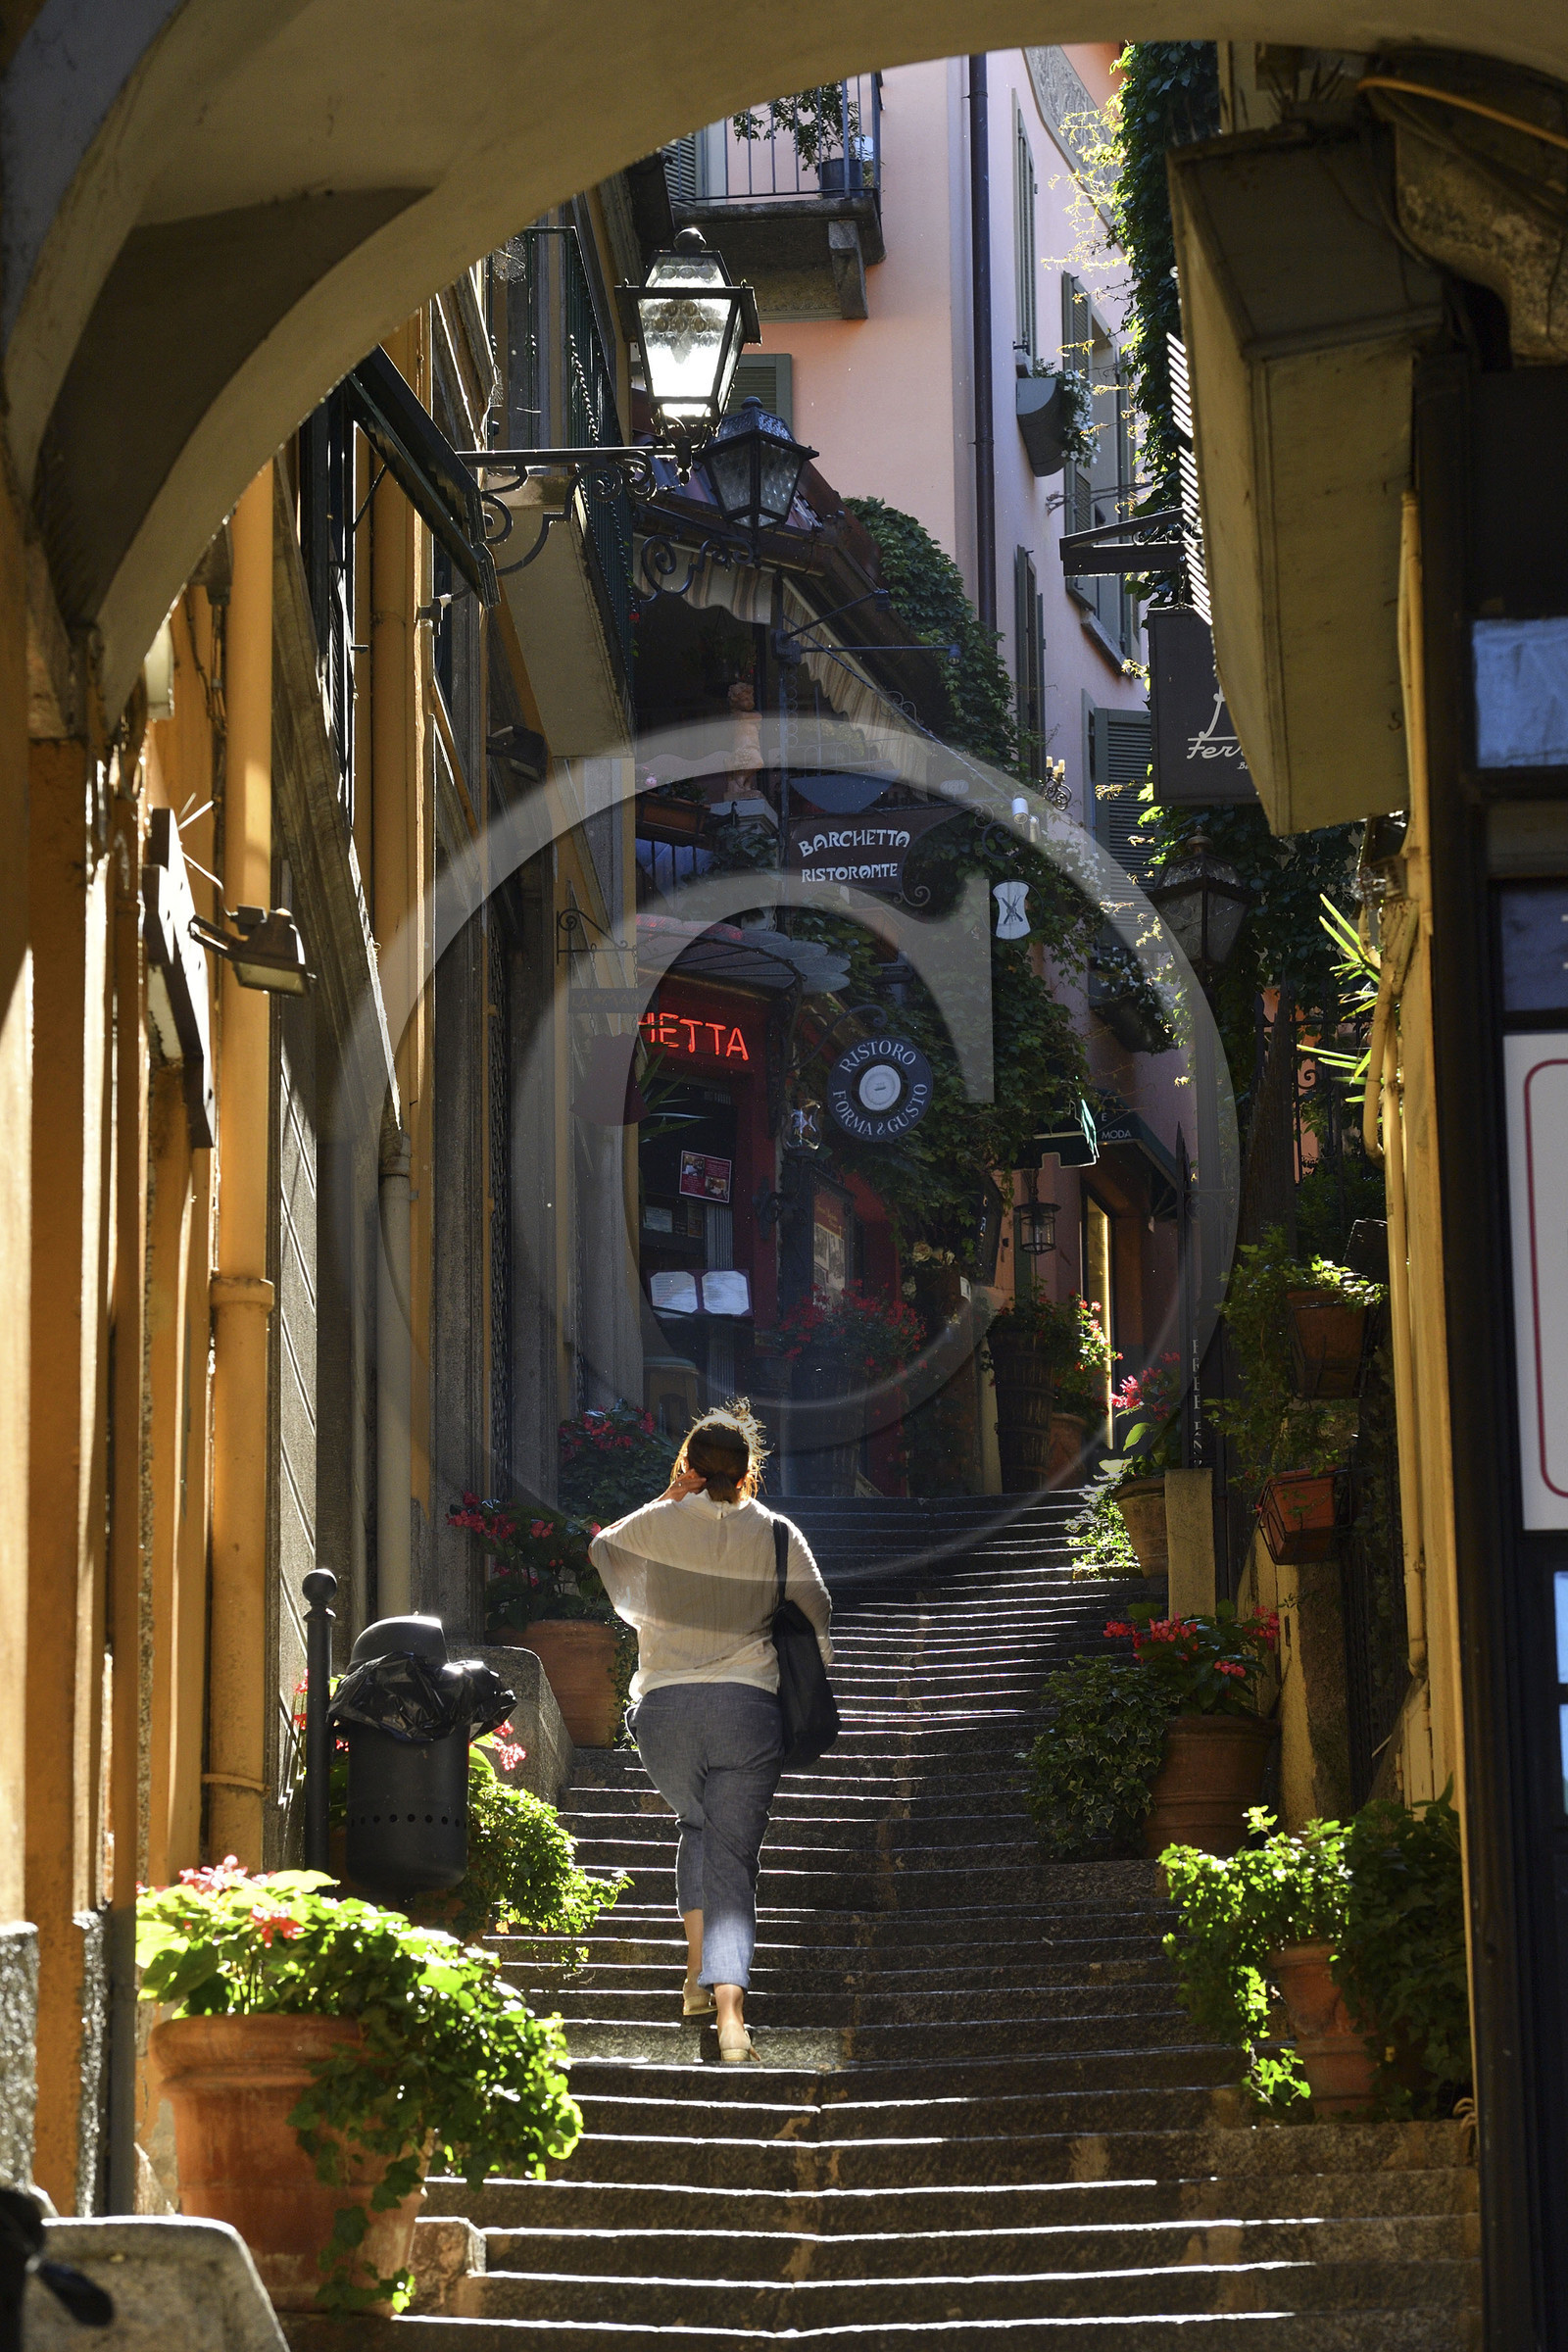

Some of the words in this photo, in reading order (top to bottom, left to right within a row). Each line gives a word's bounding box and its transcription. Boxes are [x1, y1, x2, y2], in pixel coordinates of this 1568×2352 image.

[798, 829, 910, 858] BARCHETTA
[801, 862, 899, 883] RISTORANTE
[839, 1040, 916, 1074] RISTORO
[833, 1090, 873, 1136] FORMA
[876, 1121, 887, 1136] &
[887, 1084, 928, 1133] GUSTO
[1101, 1129, 1132, 1140] MODA
